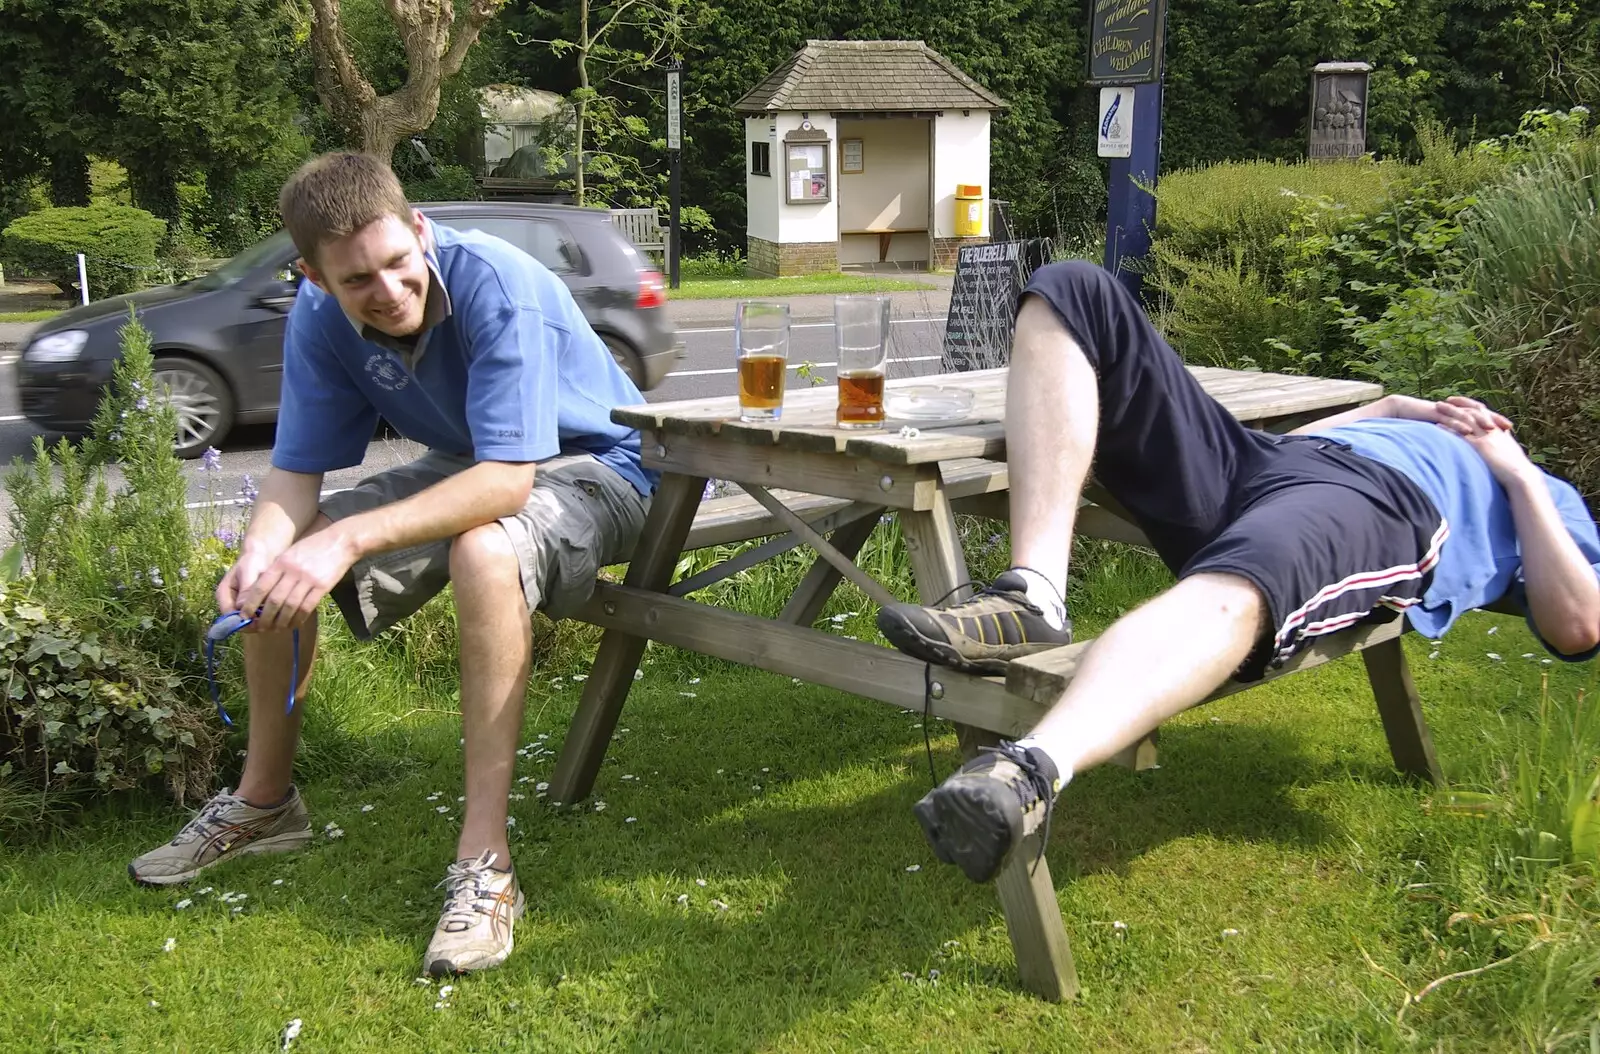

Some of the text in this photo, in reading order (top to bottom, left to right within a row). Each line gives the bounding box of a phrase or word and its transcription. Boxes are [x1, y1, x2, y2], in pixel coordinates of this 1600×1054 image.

[1093, 36, 1133, 58] CHILDREN
[1110, 40, 1151, 71] WELCOME
[1312, 143, 1364, 156] HEMPSTEAD
[960, 247, 973, 263] THE
